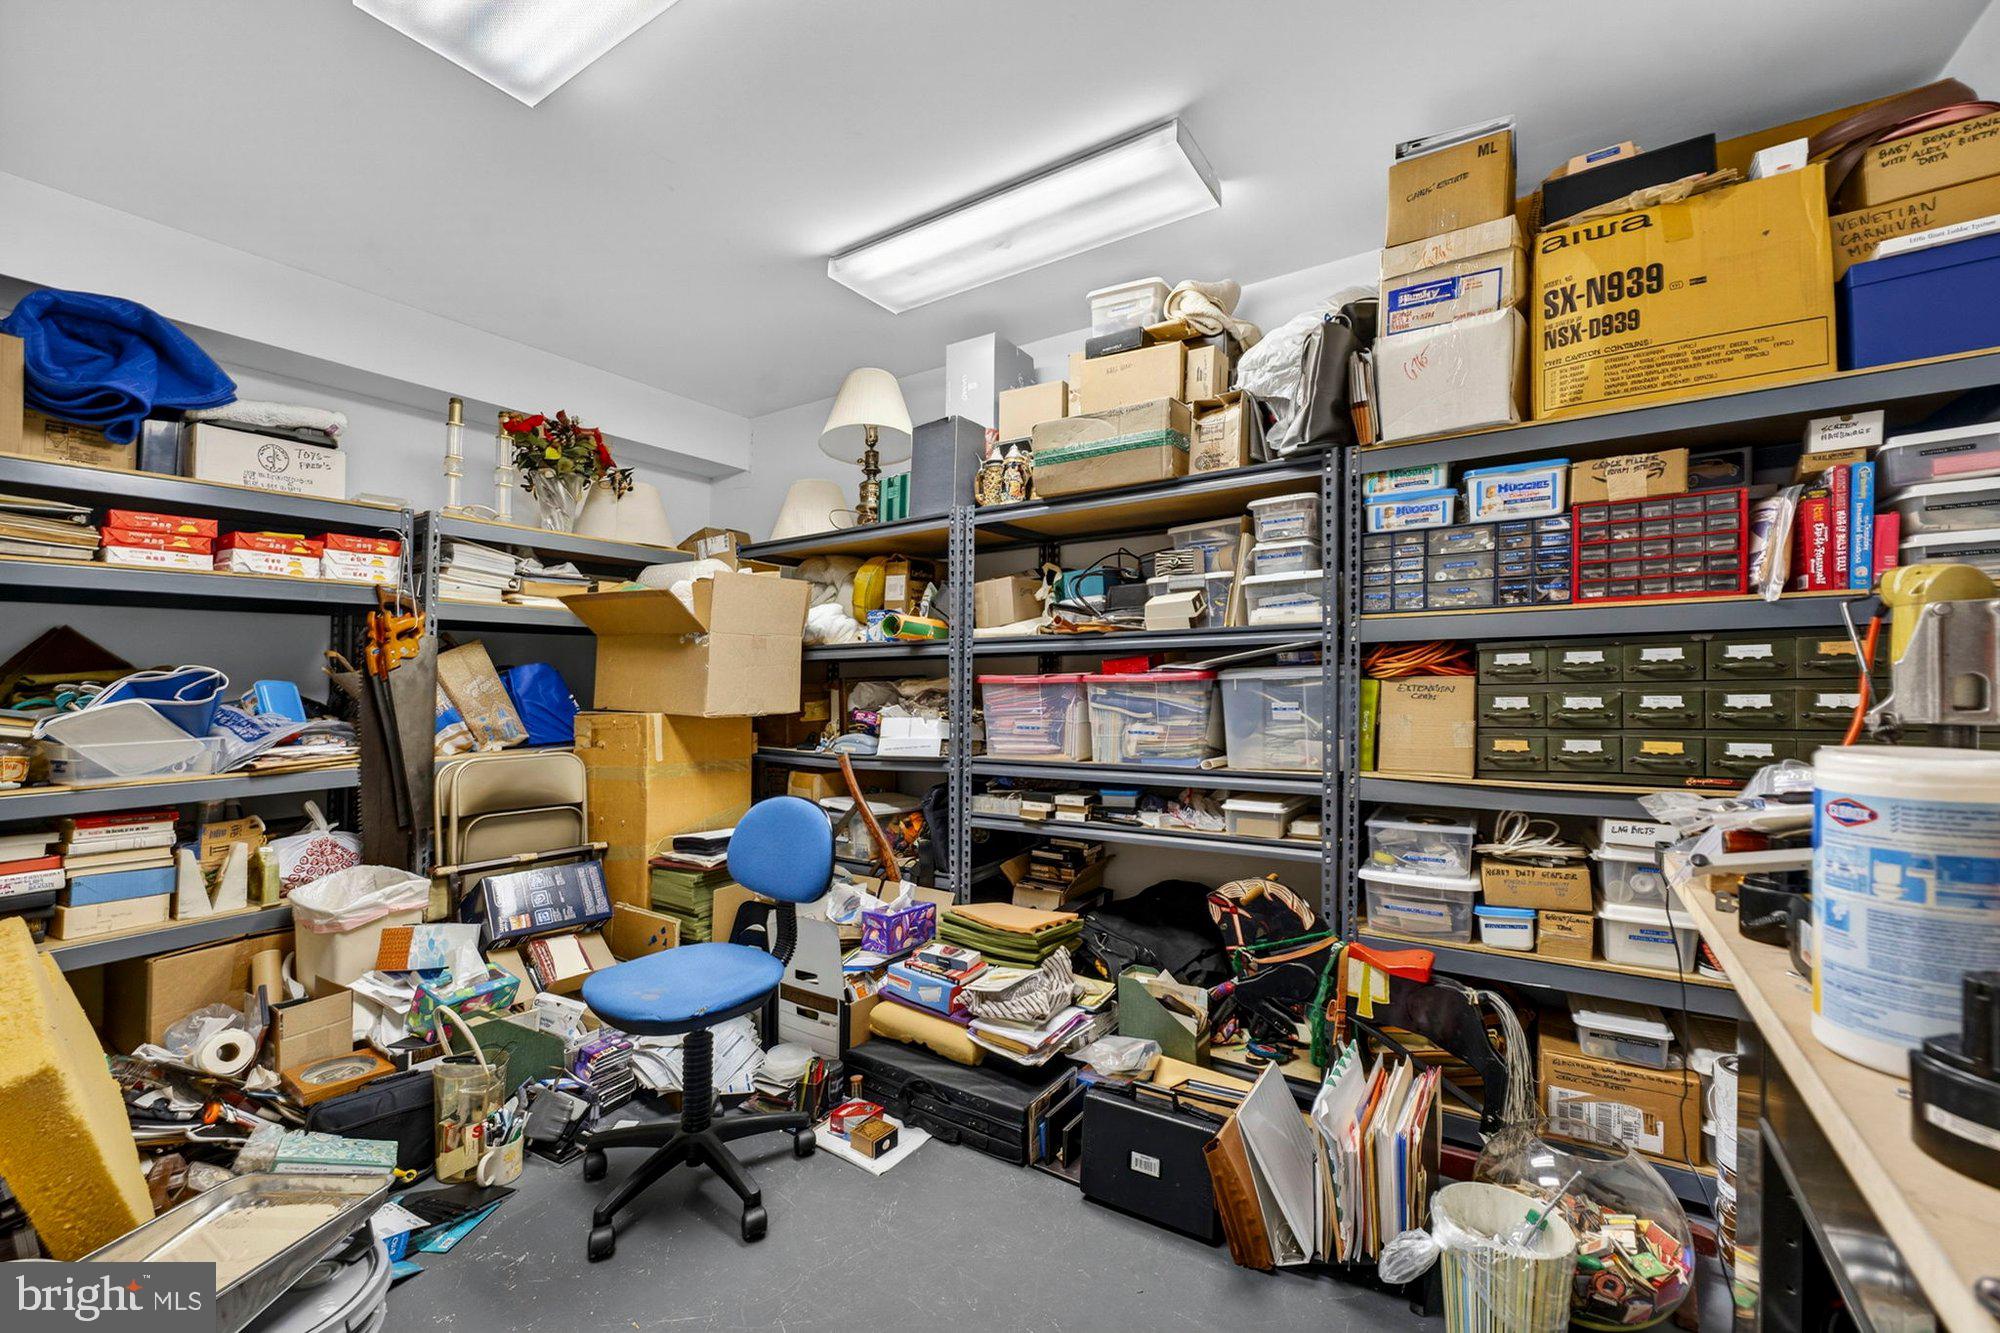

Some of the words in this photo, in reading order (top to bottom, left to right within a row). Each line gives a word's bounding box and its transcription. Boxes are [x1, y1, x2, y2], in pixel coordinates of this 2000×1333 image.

[1477, 141, 1498, 158] ML
[1918, 152, 1949, 166] DATA
[1836, 196, 1937, 233] VENETIAN
[1541, 213, 1653, 255] aiwa
[1840, 213, 1935, 247] CARNIVAL
[1543, 262, 1665, 321] SX-N939
[1543, 307, 1641, 352] NSX-D939
[1497, 478, 1551, 494] HUGGIES
[1394, 502, 1441, 518] HUGGIES
[1611, 826, 1629, 836] LAG
[1514, 867, 1537, 878] DUTY
